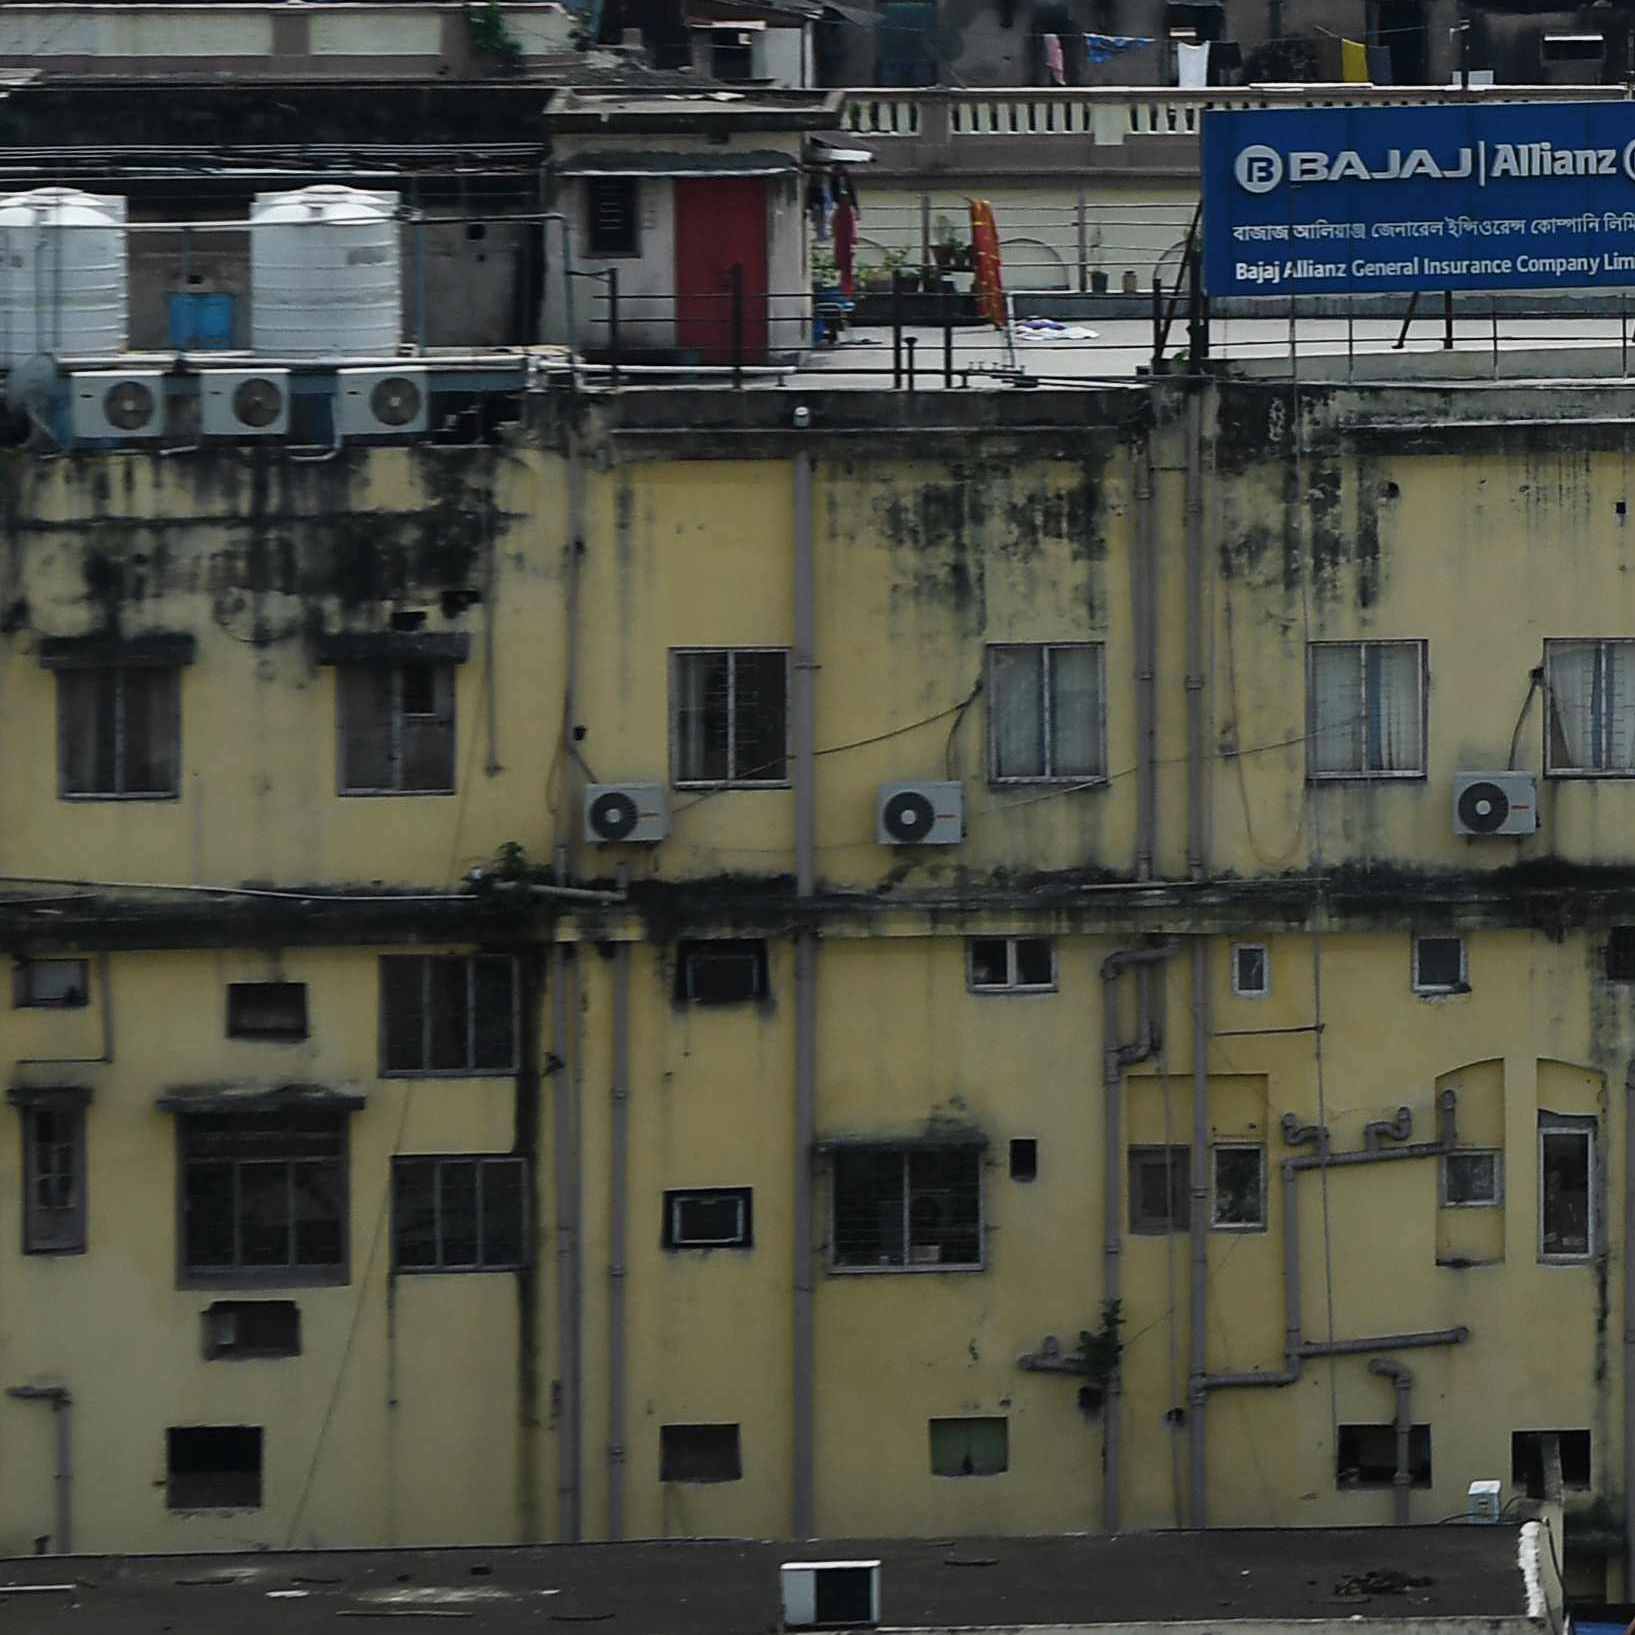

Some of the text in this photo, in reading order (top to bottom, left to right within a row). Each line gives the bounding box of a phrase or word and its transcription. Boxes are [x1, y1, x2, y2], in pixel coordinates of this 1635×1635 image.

[1288, 148, 1472, 182] BAJAJ
[1490, 141, 1617, 178] Allianz
[1232, 225, 1289, 241] বাজাজ
[1371, 221, 1443, 238] জেনারেল
[1530, 213, 1600, 233] কোম্পানি
[1235, 262, 1281, 284] Bajaj
[1283, 260, 1347, 278] Allianz
[1351, 257, 1419, 276] General
[1423, 257, 1512, 275] Insurance
[1516, 255, 1600, 276] Company
